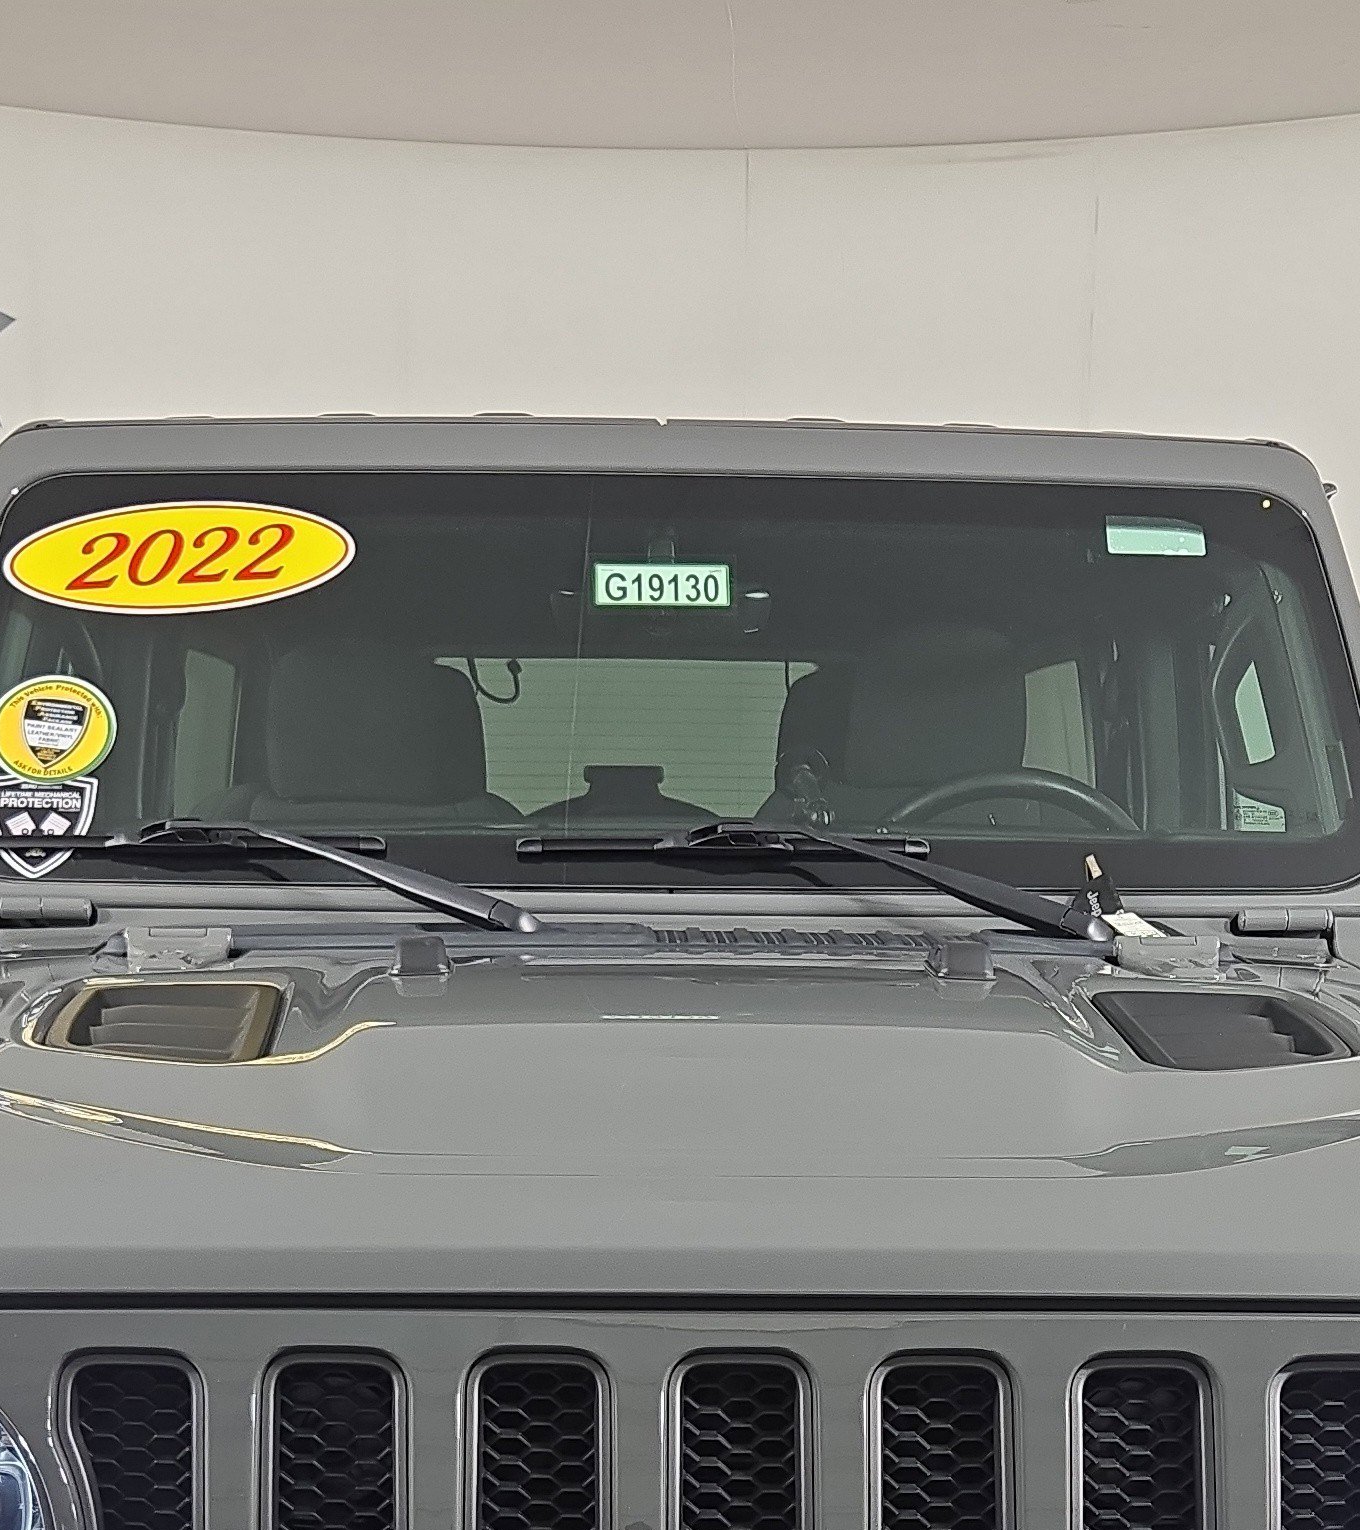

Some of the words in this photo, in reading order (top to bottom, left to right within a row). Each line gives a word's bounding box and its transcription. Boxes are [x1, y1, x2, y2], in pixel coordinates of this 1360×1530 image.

[65, 523, 295, 591] 2022
[605, 573, 719, 602] G19130
[9, 694, 25, 708] This
[24, 685, 54, 697] Vehicle
[55, 684, 93, 701] Protected
[13, 760, 27, 770] ASK
[27, 766, 42, 775] FOR
[43, 766, 73, 776] DETAILS
[0, 797, 82, 809] PROTECTION
[1086, 890, 1102, 918] Jeep
